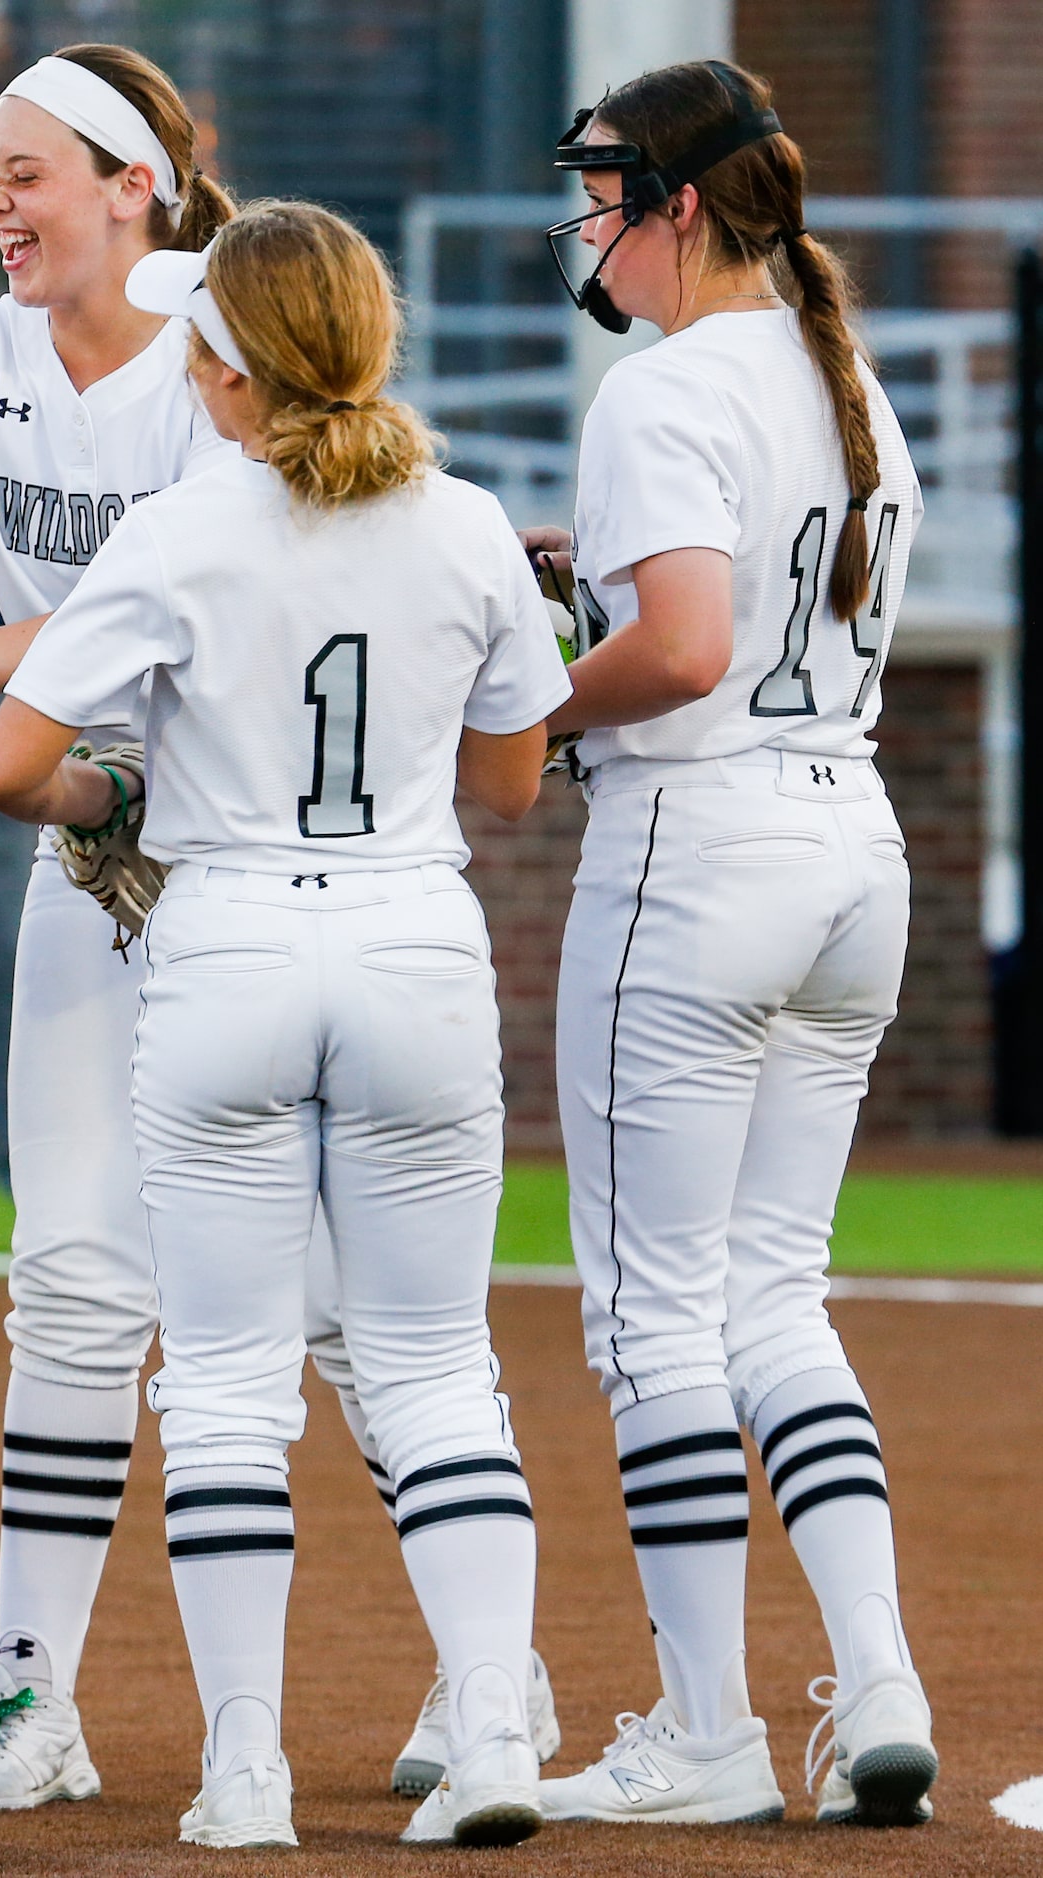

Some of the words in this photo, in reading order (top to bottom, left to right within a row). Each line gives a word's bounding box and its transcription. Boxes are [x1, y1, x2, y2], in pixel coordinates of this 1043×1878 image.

[750, 503, 898, 717] 14
[298, 633, 376, 838] 1
[609, 1753, 674, 1804] N
